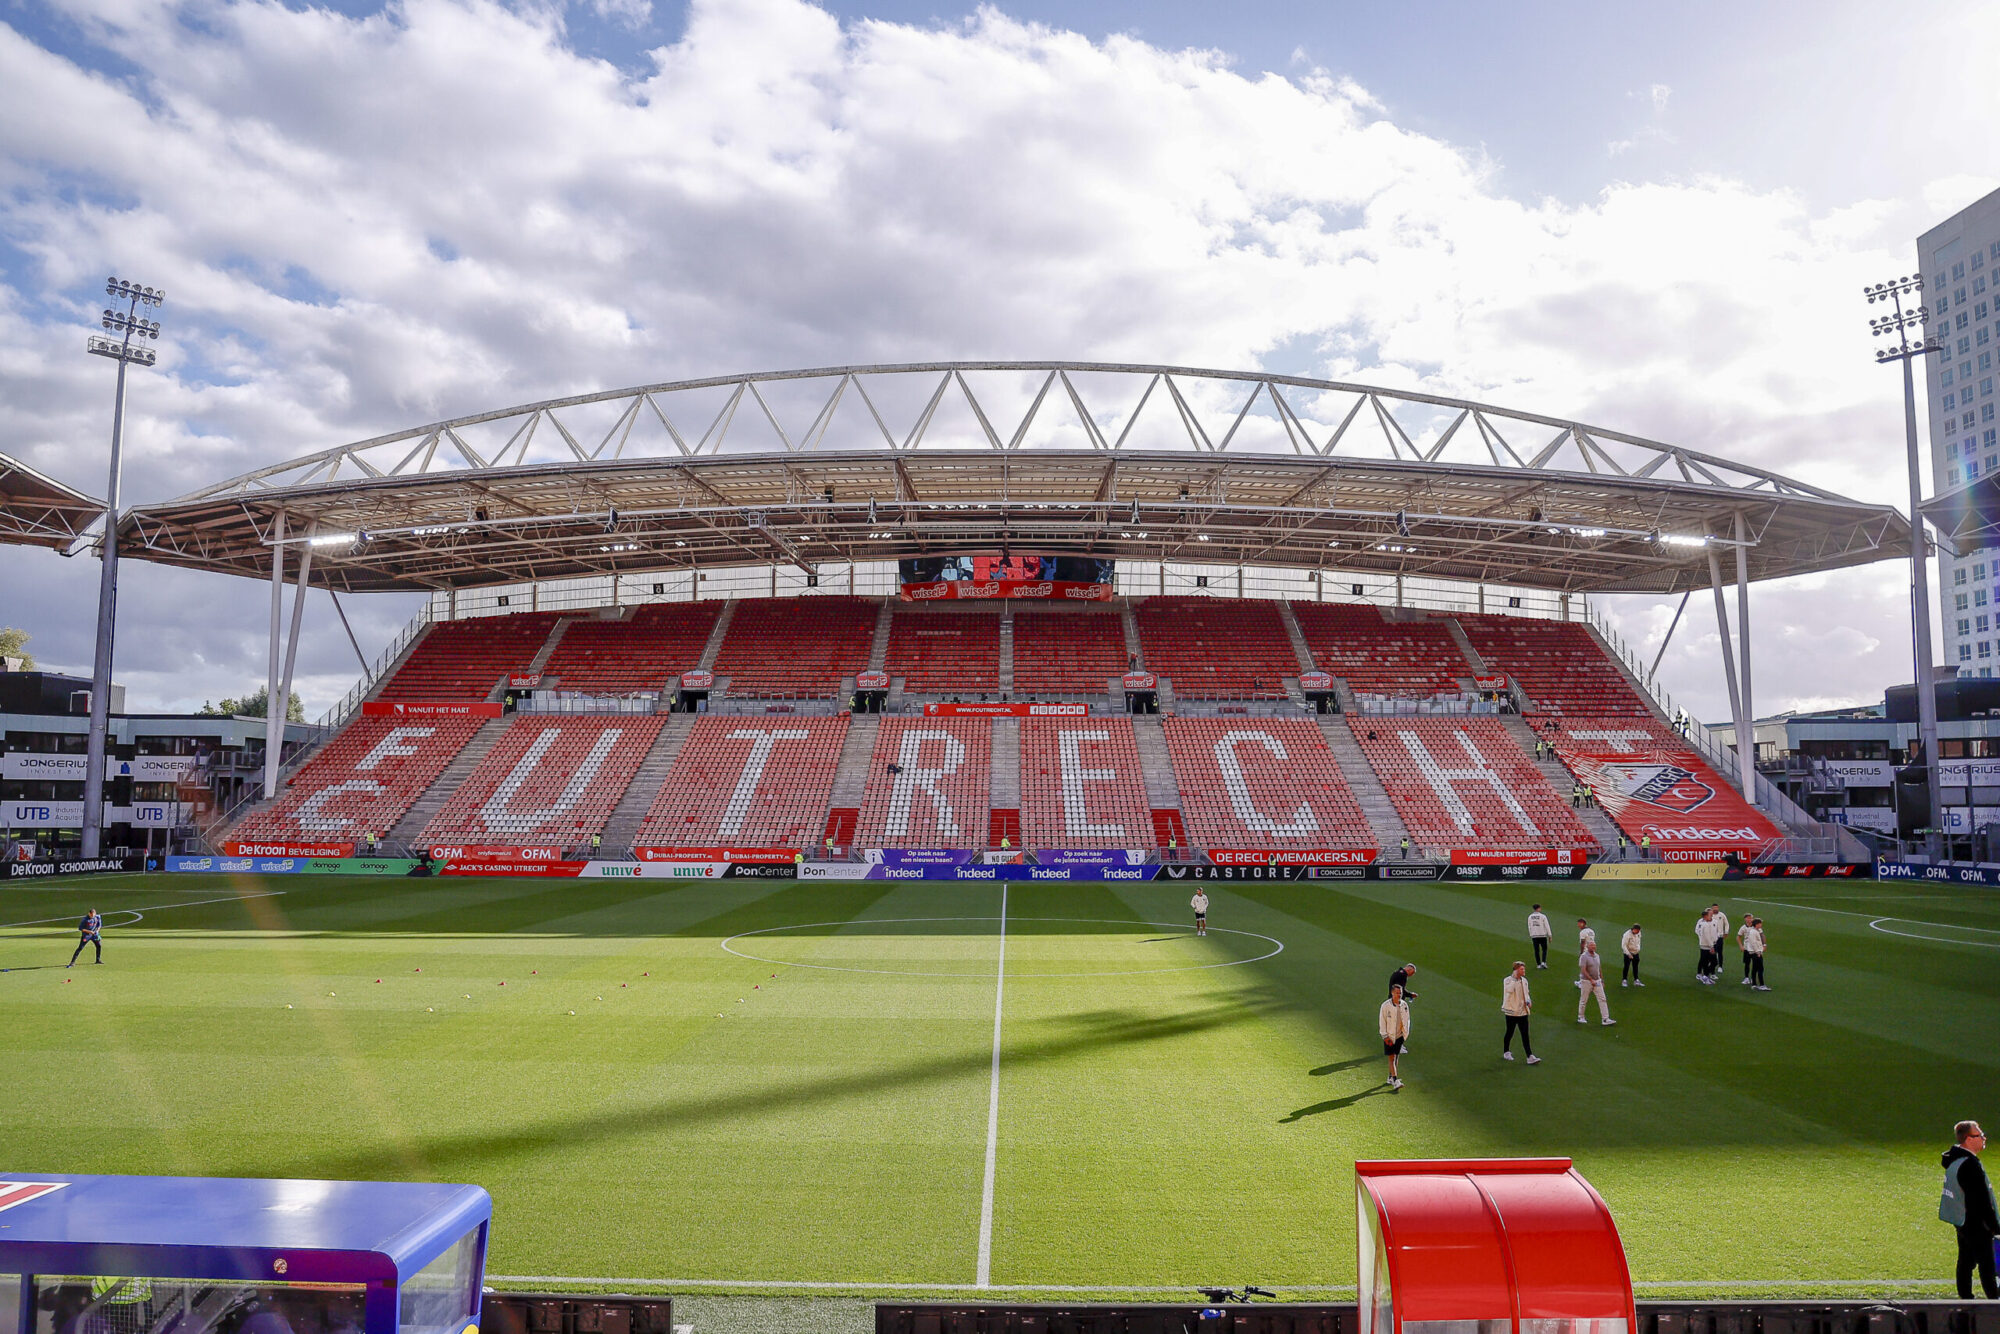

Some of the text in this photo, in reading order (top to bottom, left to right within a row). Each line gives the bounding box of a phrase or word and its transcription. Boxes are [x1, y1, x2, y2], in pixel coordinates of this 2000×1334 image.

[912, 587, 940, 598] wissel
[960, 586, 991, 597] wissel
[1014, 586, 1044, 597] wissel
[1065, 587, 1095, 598] wissel
[142, 762, 190, 770] JONGERI
[16, 807, 50, 820] UTB
[136, 807, 163, 820] UTB
[1641, 825, 1761, 841] indeed
[289, 848, 340, 856] BEVEILIGING
[1216, 852, 1232, 862] DE
[1664, 851, 1747, 861] KOOTINFRAL
[60, 860, 123, 873] SCHOONMAAK
[735, 866, 795, 876] PonCenter
[803, 866, 862, 876] PonCenter
[1457, 867, 1482, 875] DASSY
[1502, 867, 1527, 875] DASSY
[1547, 867, 1573, 875] DASSY
[1747, 865, 1766, 874] Bud
[1788, 865, 1806, 874] Bud
[1829, 865, 1847, 874] Bud
[884, 866, 923, 878] indeed
[955, 866, 995, 878] indeed
[1029, 867, 1070, 879] indeed
[1102, 867, 1142, 879] indeed
[1195, 867, 1291, 878] CASTORE
[1320, 868, 1362, 876] CONCLUSION
[1391, 868, 1433, 876] CONCLUSION
